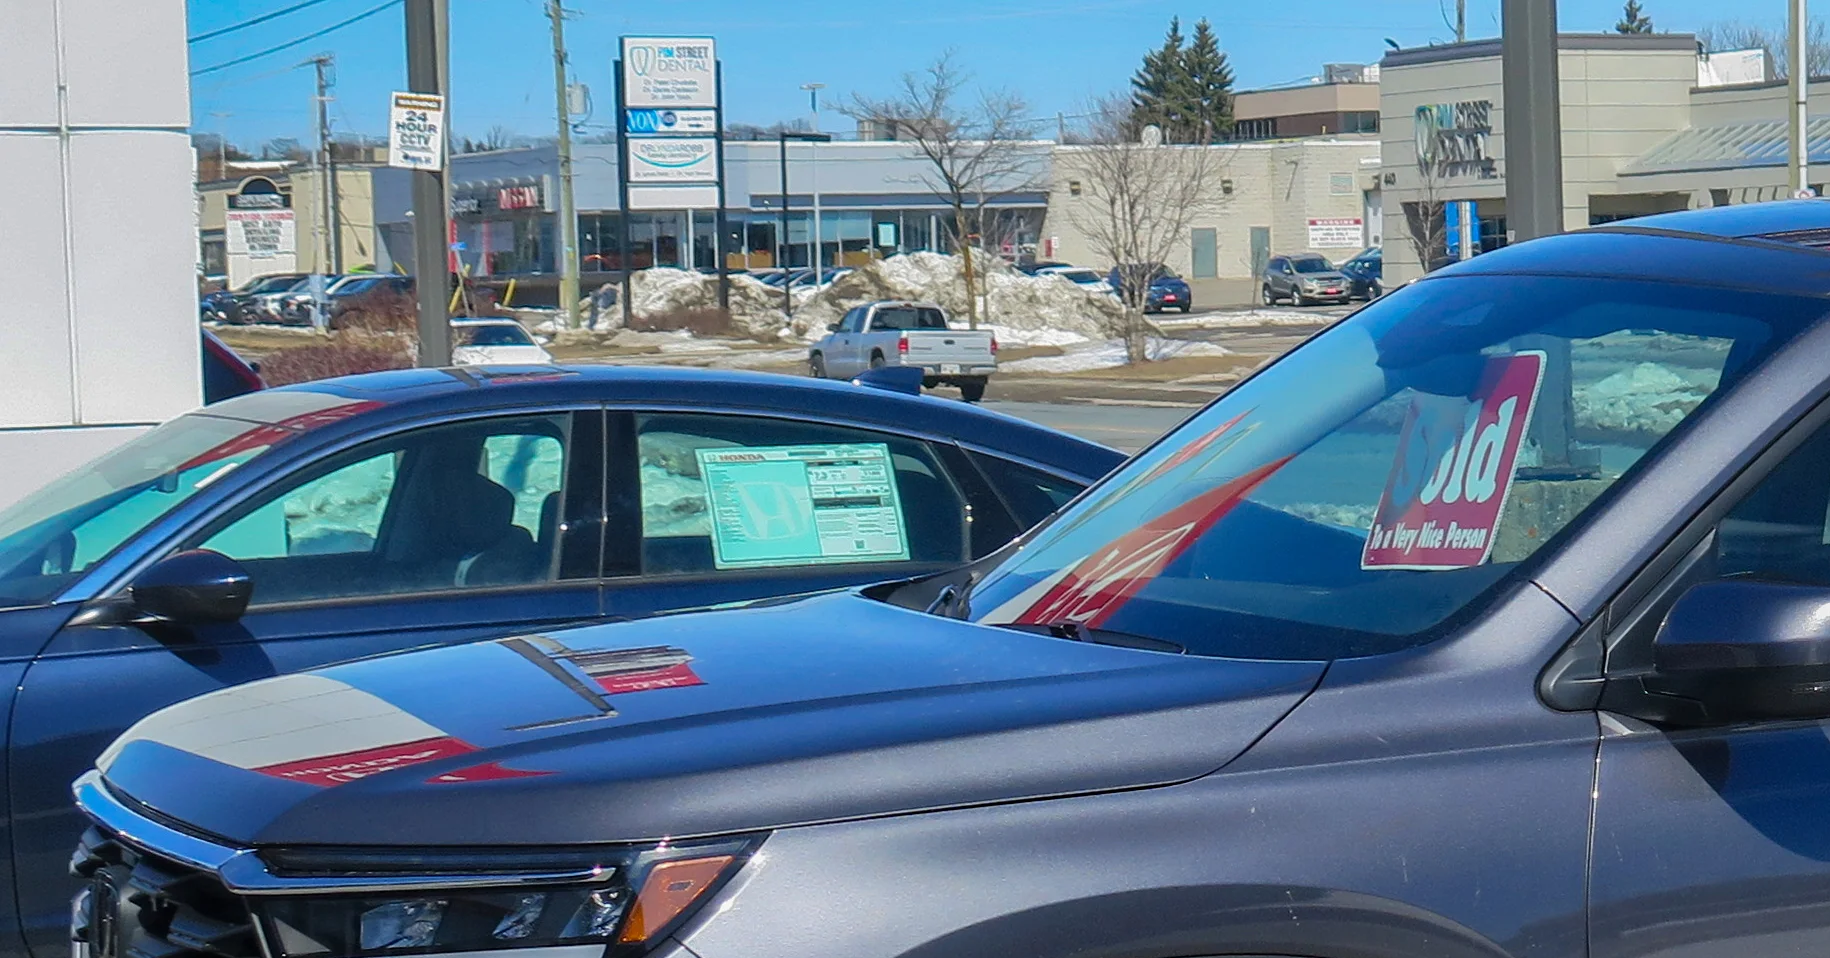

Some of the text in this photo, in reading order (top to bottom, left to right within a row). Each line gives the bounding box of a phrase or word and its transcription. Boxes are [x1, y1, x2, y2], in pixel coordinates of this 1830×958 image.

[676, 46, 709, 59] STREET
[657, 59, 710, 73] DENTAL
[405, 110, 428, 122] 24
[395, 121, 438, 134] HOUR
[399, 133, 431, 146] CCTV
[718, 453, 765, 462] HONDA
[1370, 519, 1488, 555] To a Very Nice Person
